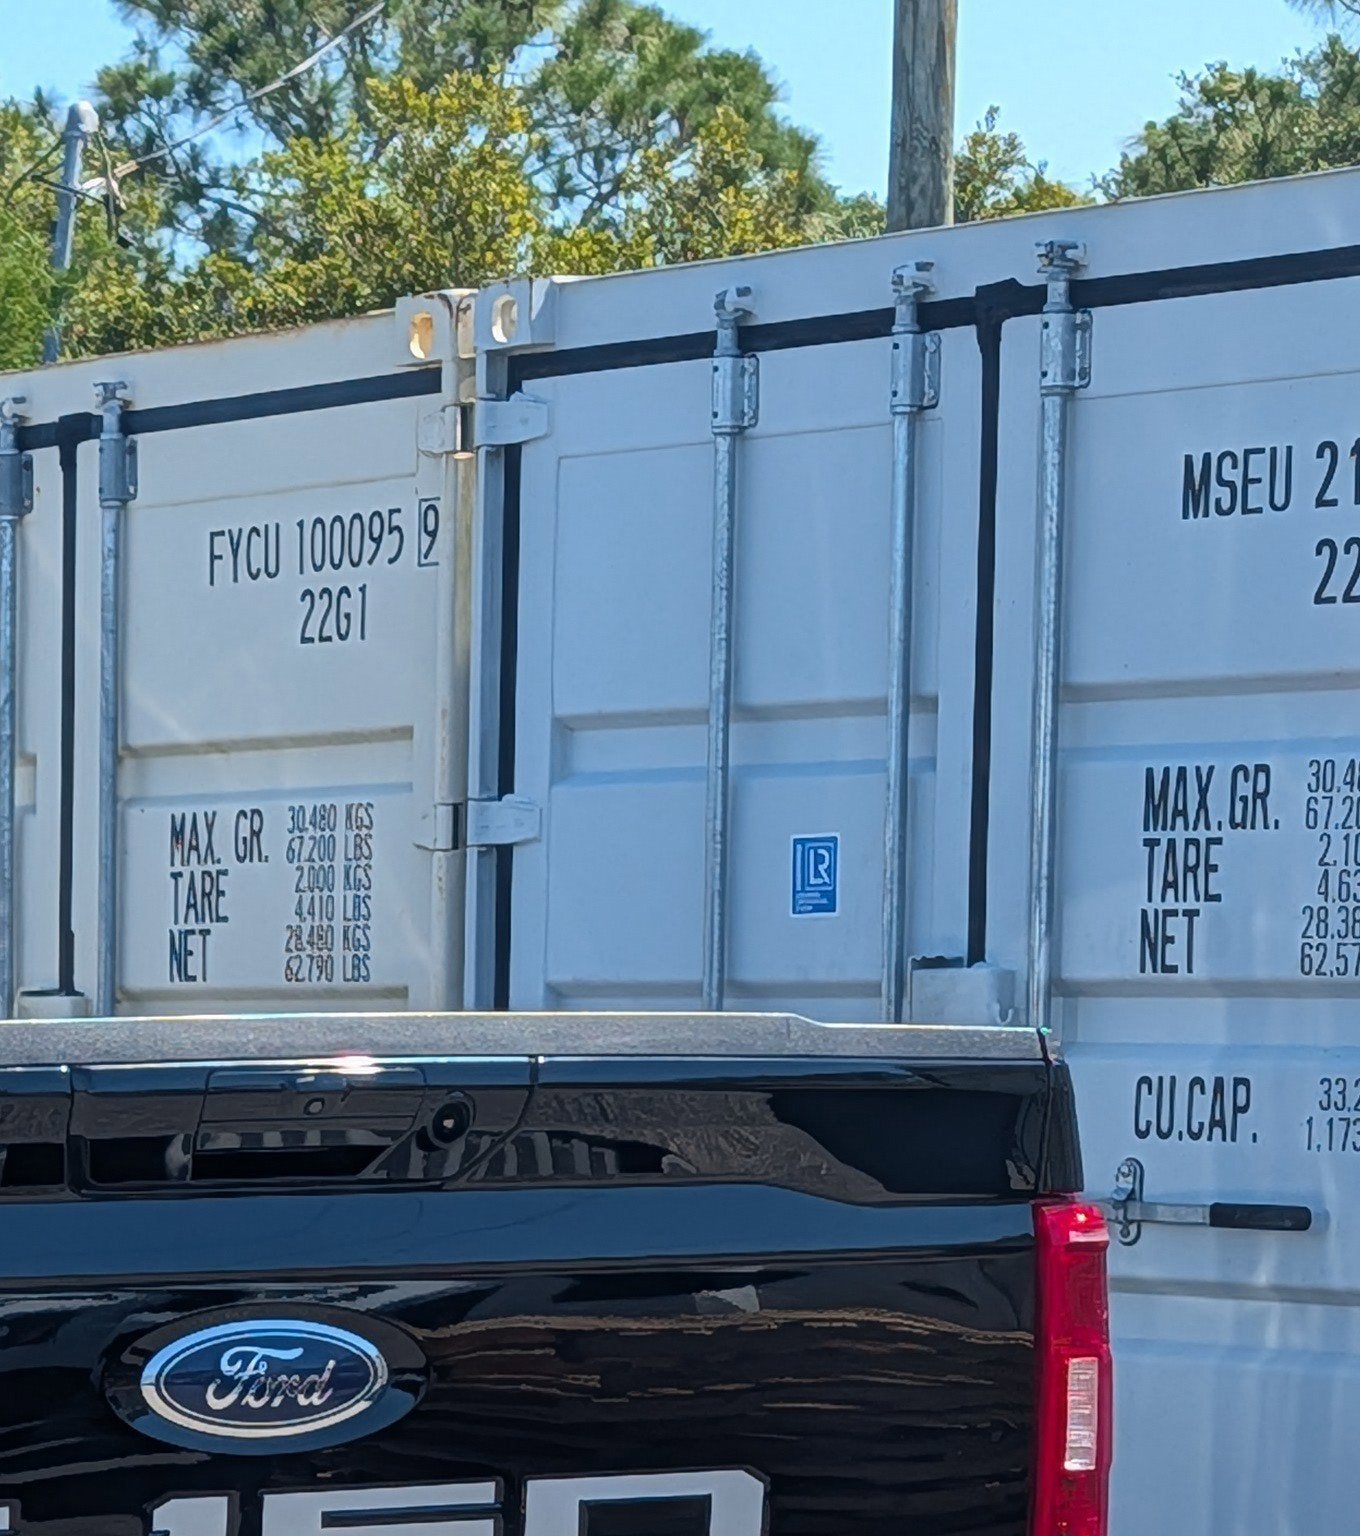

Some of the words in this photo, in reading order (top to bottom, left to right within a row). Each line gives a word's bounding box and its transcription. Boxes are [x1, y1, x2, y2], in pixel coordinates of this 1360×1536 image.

[1182, 445, 1293, 520] MSEU
[209, 522, 280, 586] FYCU
[296, 508, 404, 575] 100095
[423, 503, 440, 560] 9
[1313, 536, 1360, 605] 22
[299, 583, 367, 644] 22G1
[1307, 759, 1360, 798] 30.4
[170, 810, 221, 867] MAX.
[234, 808, 269, 863] GR.
[345, 802, 374, 832] KGS
[344, 833, 373, 862] LBS
[1142, 837, 1223, 903] TARE
[170, 869, 229, 925] TARE
[343, 863, 372, 891] KGS
[343, 894, 371, 922] LBS
[169, 929, 211, 983] NET
[342, 953, 371, 983] LBS
[1139, 908, 1201, 974] NET
[205, 1346, 336, 1410] Ford
